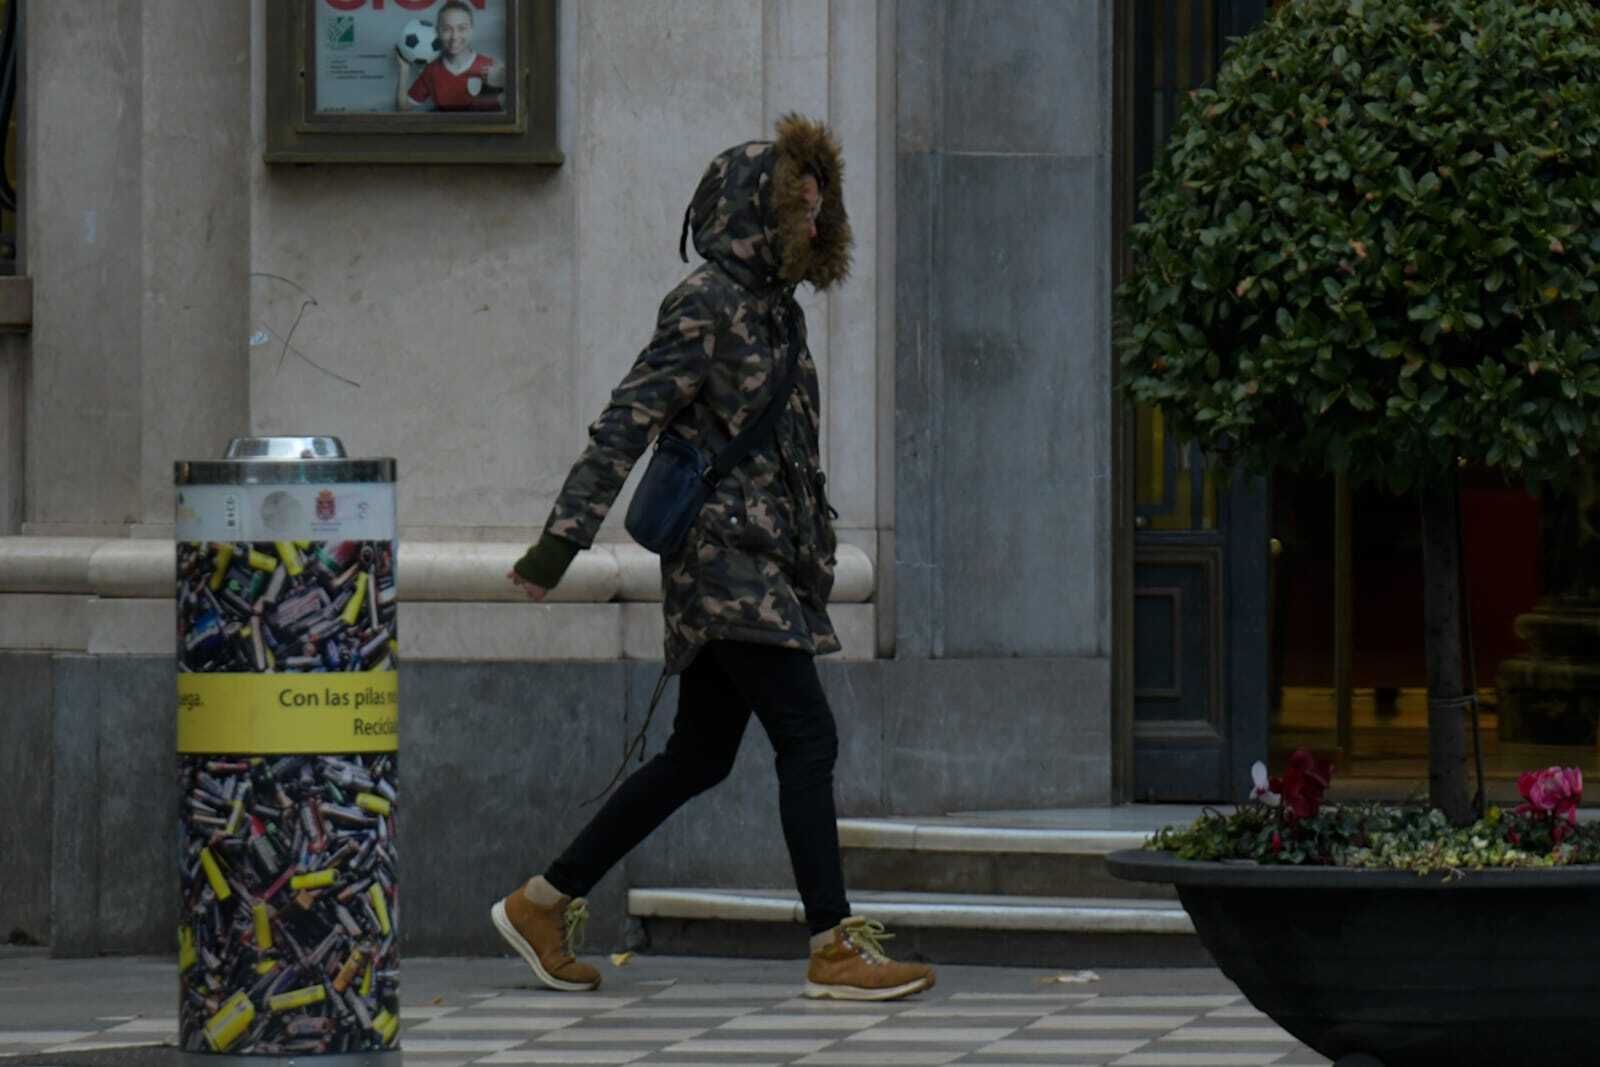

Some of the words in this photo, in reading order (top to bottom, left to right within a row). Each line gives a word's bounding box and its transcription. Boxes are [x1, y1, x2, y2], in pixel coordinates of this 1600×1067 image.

[279, 689, 319, 707] Con
[324, 688, 349, 706] las
[355, 687, 385, 709] pilas
